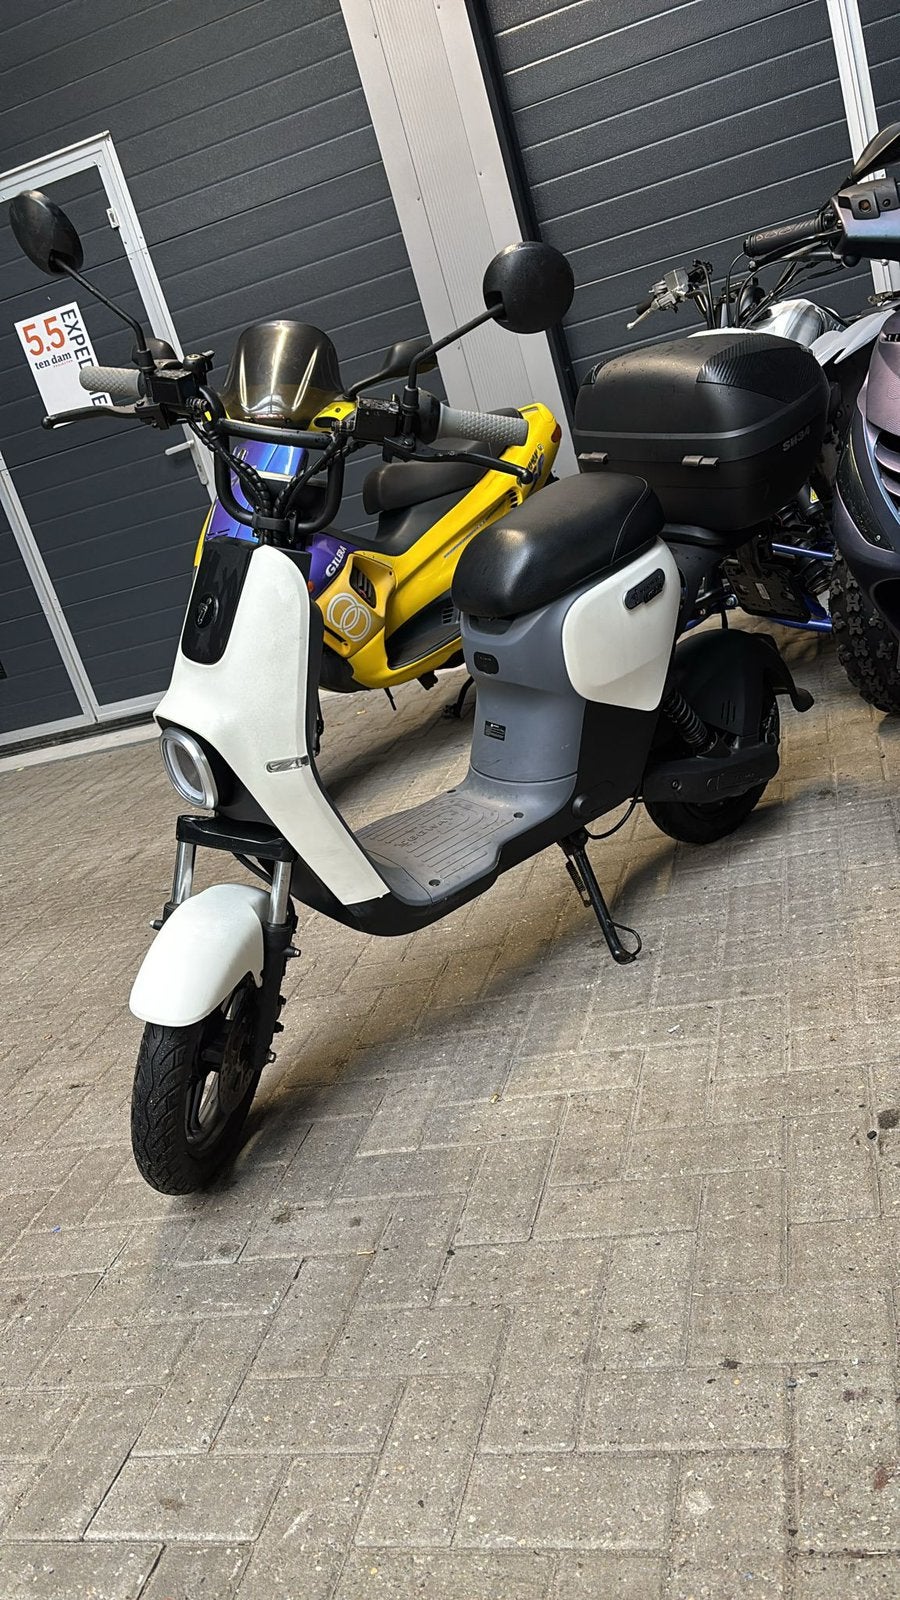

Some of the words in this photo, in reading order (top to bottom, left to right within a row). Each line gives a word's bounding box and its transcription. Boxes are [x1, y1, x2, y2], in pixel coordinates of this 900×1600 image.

[22, 316, 65, 356] 5.5
[35, 360, 51, 370] ten
[51, 352, 72, 365] dam
